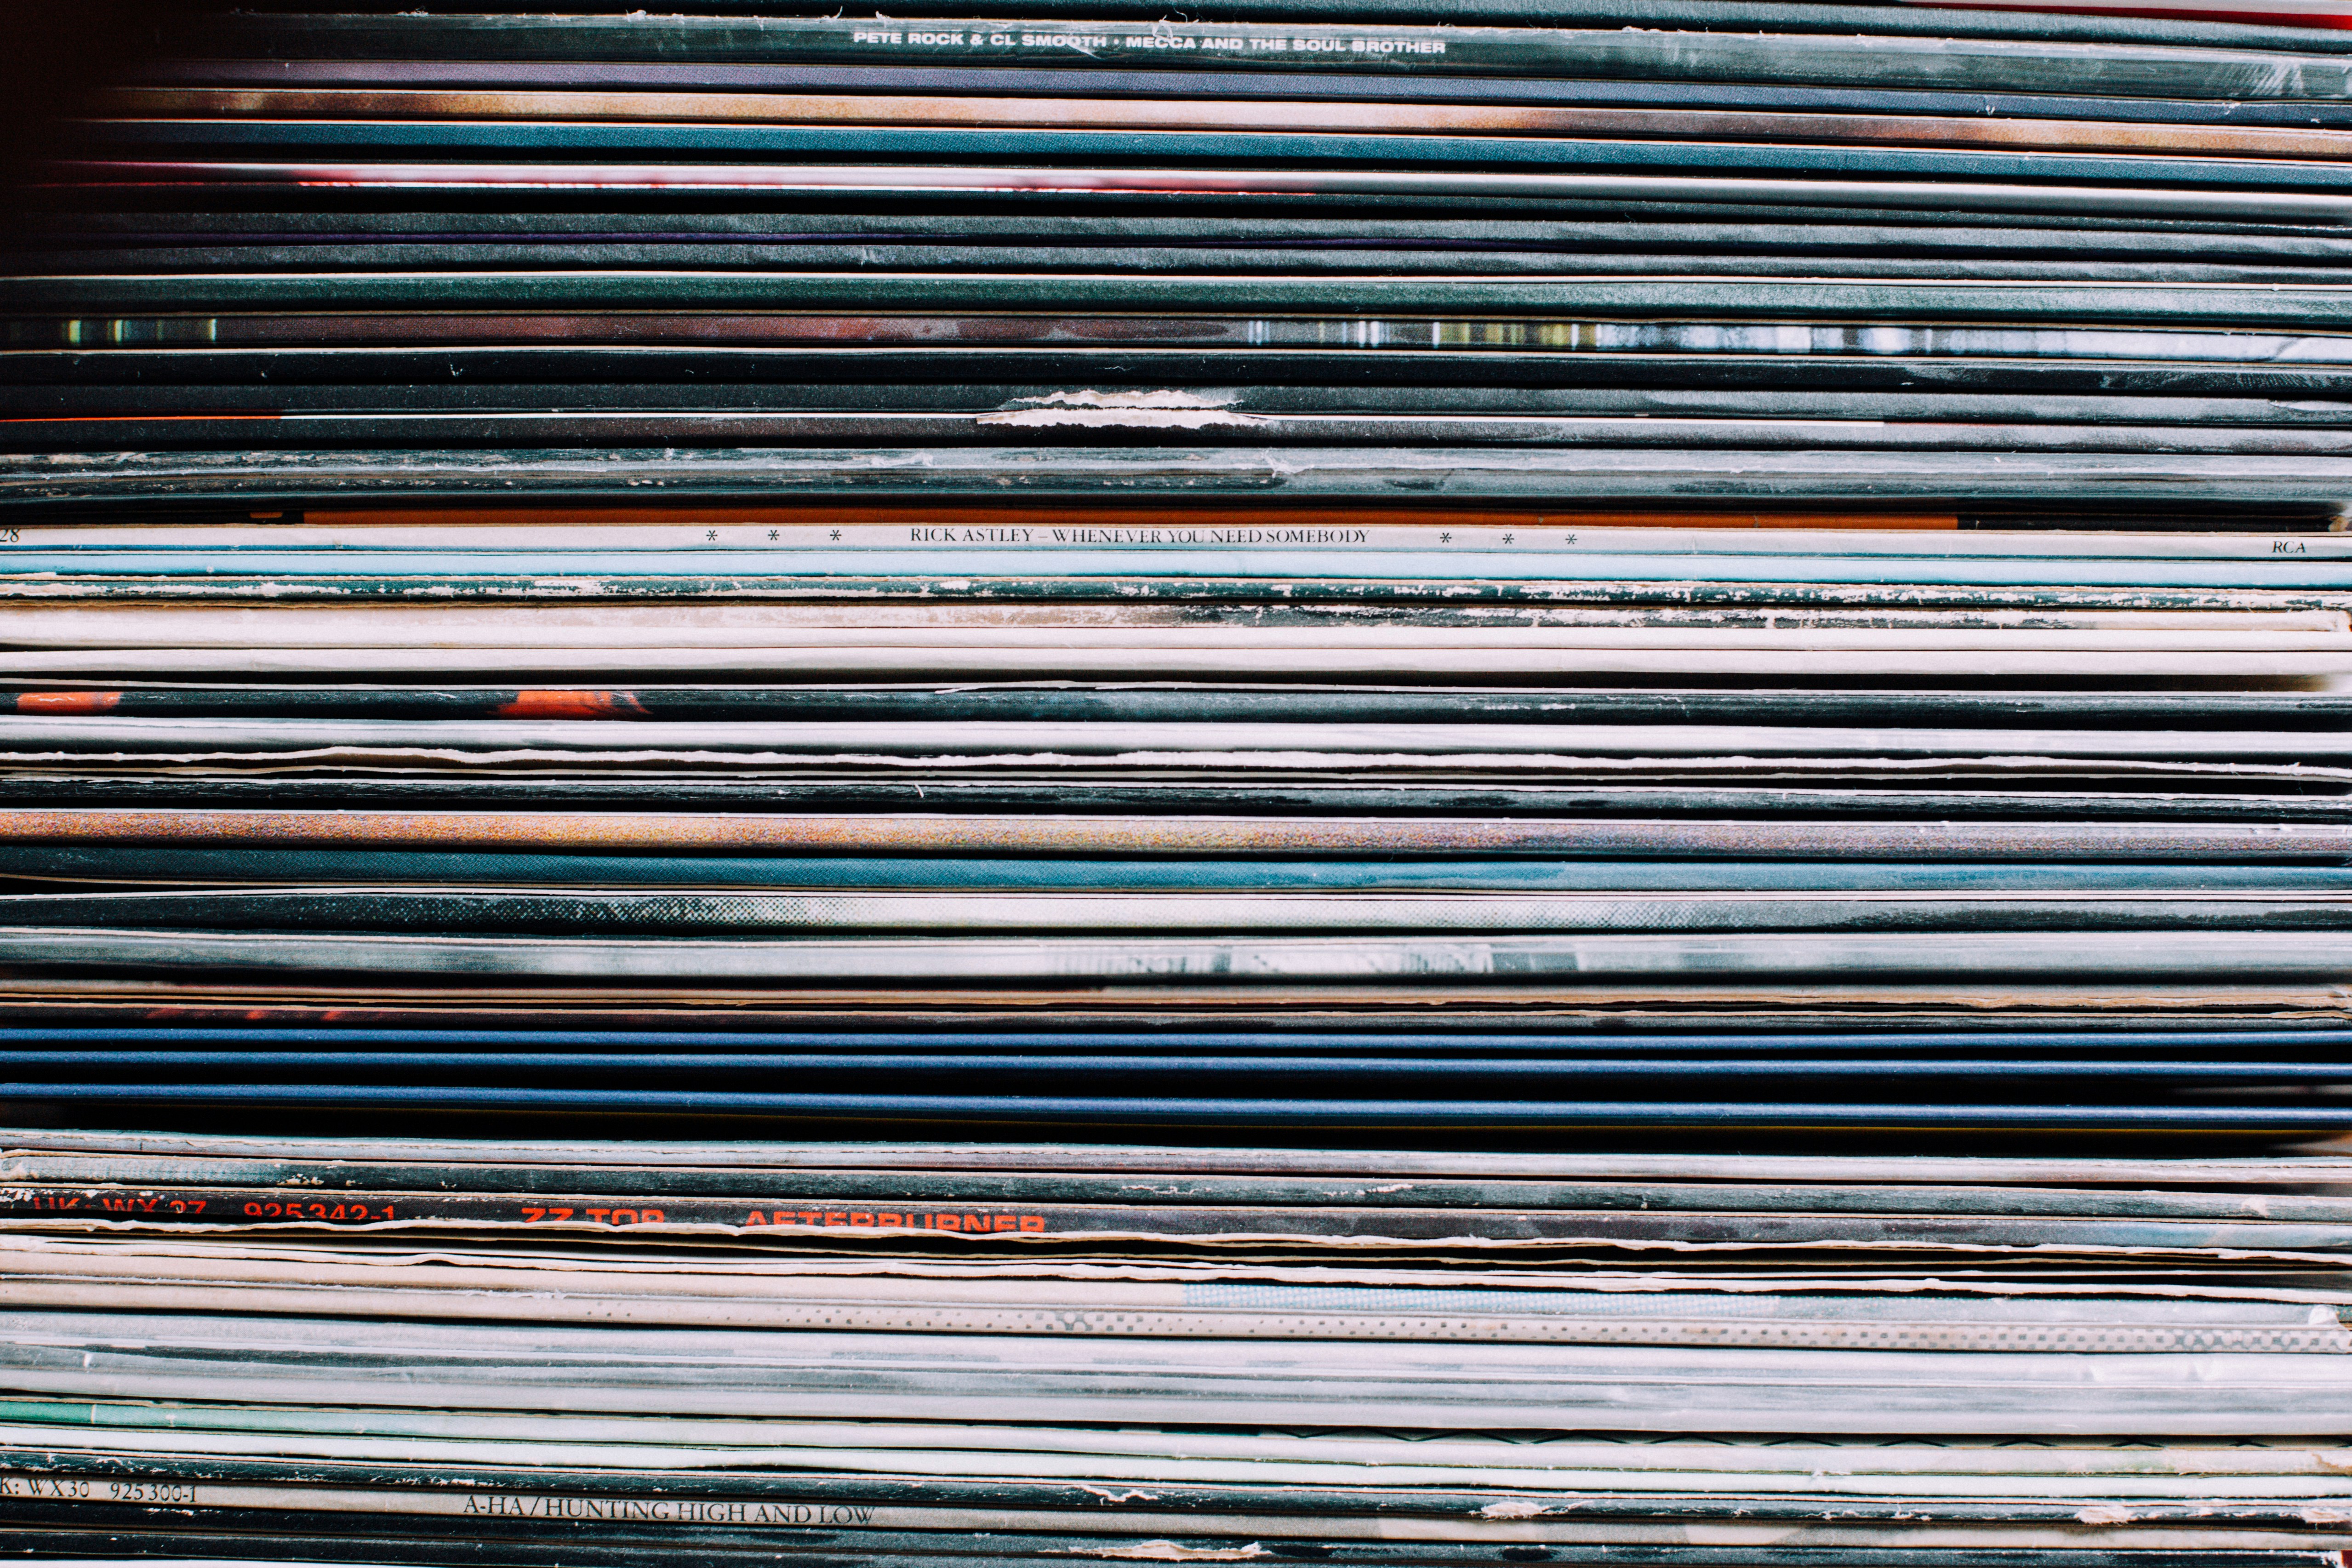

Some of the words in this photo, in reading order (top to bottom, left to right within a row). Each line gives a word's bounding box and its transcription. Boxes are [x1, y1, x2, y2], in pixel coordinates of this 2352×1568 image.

[854, 32, 902, 45] PETE
[908, 33, 964, 46] ROCK
[970, 34, 984, 46] &
[990, 34, 1016, 46] CL
[1022, 34, 1107, 47] SMOOTH
[1126, 36, 1196, 49] MECCA
[1202, 38, 1243, 50] AND
[1249, 38, 1287, 51] THE
[1293, 39, 1345, 52] SOUL
[1352, 40, 1446, 53] BROTHER
[910, 528, 957, 542] RICK
[962, 528, 1034, 542] ASTLEY
[1052, 529, 1162, 543] WHENEVER
[1168, 530, 1205, 543] YOU
[1211, 530, 1262, 543] NEED
[1266, 530, 1370, 543] SOMEBODY
[2272, 541, 2306, 553] RCA
[678, 1503, 747, 1522] HIGH
[754, 1505, 811, 1523] AND
[820, 1506, 875, 1524] LOW
